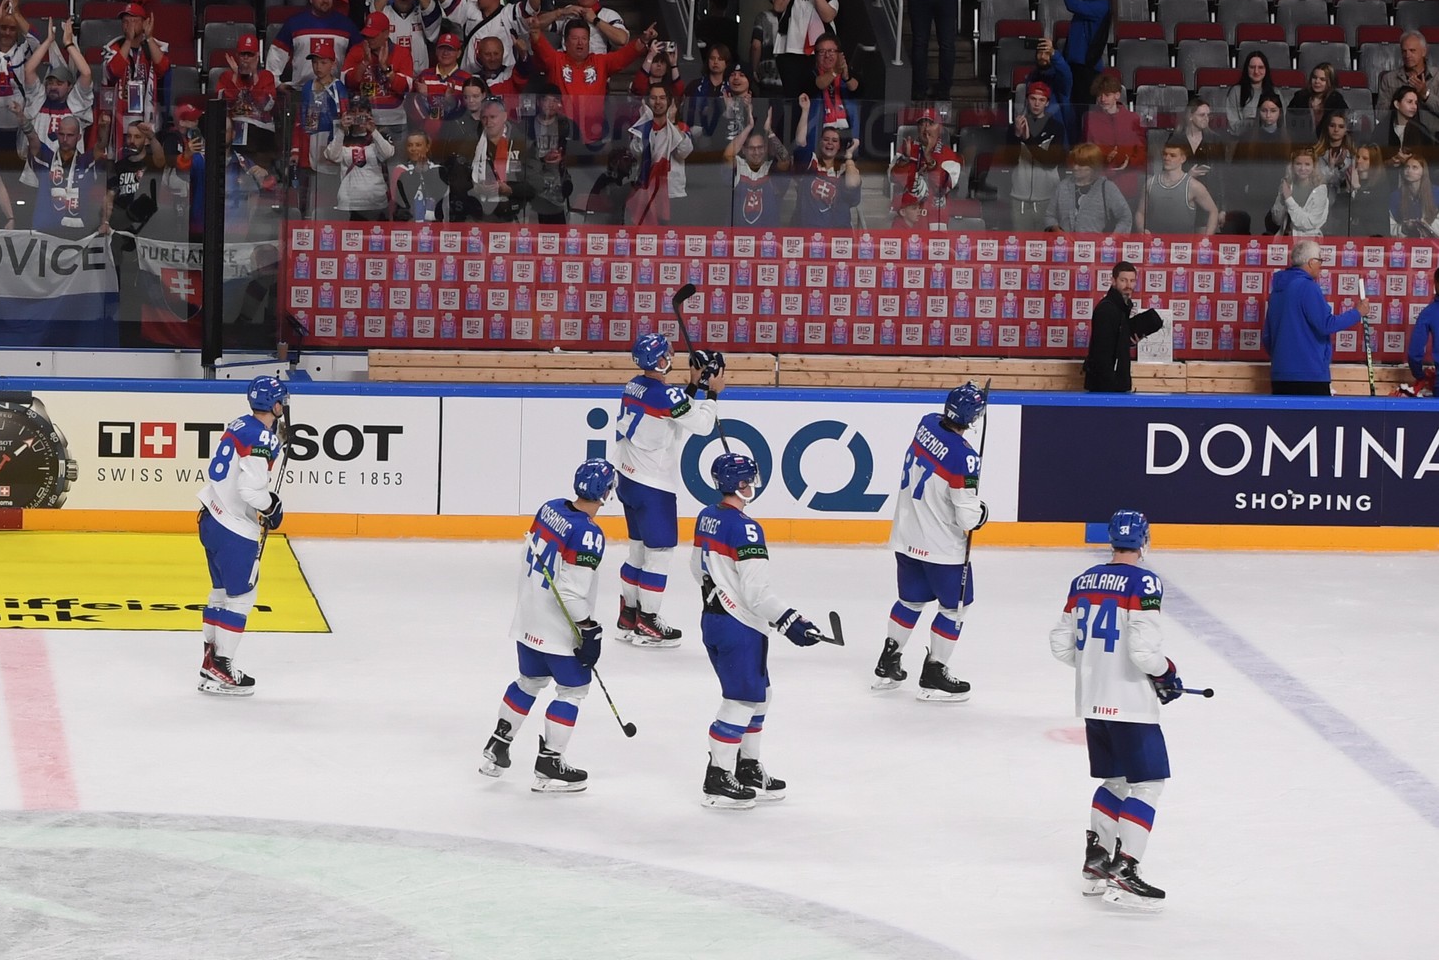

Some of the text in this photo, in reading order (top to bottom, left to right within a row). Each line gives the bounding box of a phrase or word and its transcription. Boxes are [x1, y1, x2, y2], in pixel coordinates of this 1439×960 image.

[184, 422, 404, 462] TSOT
[259, 428, 279, 451] 48
[916, 424, 950, 462] REGENDA
[97, 467, 163, 482] SWISS
[285, 470, 347, 485] SINCE
[360, 471, 403, 486] 1853
[1234, 492, 1373, 512] SHOPPING
[698, 516, 721, 536] NEMEC
[745, 523, 759, 543] 5
[1119, 525, 1131, 536] 34
[581, 529, 603, 553] 44
[1076, 572, 1129, 592] CEHLARIK
[1098, 705, 1119, 716] IIHF
